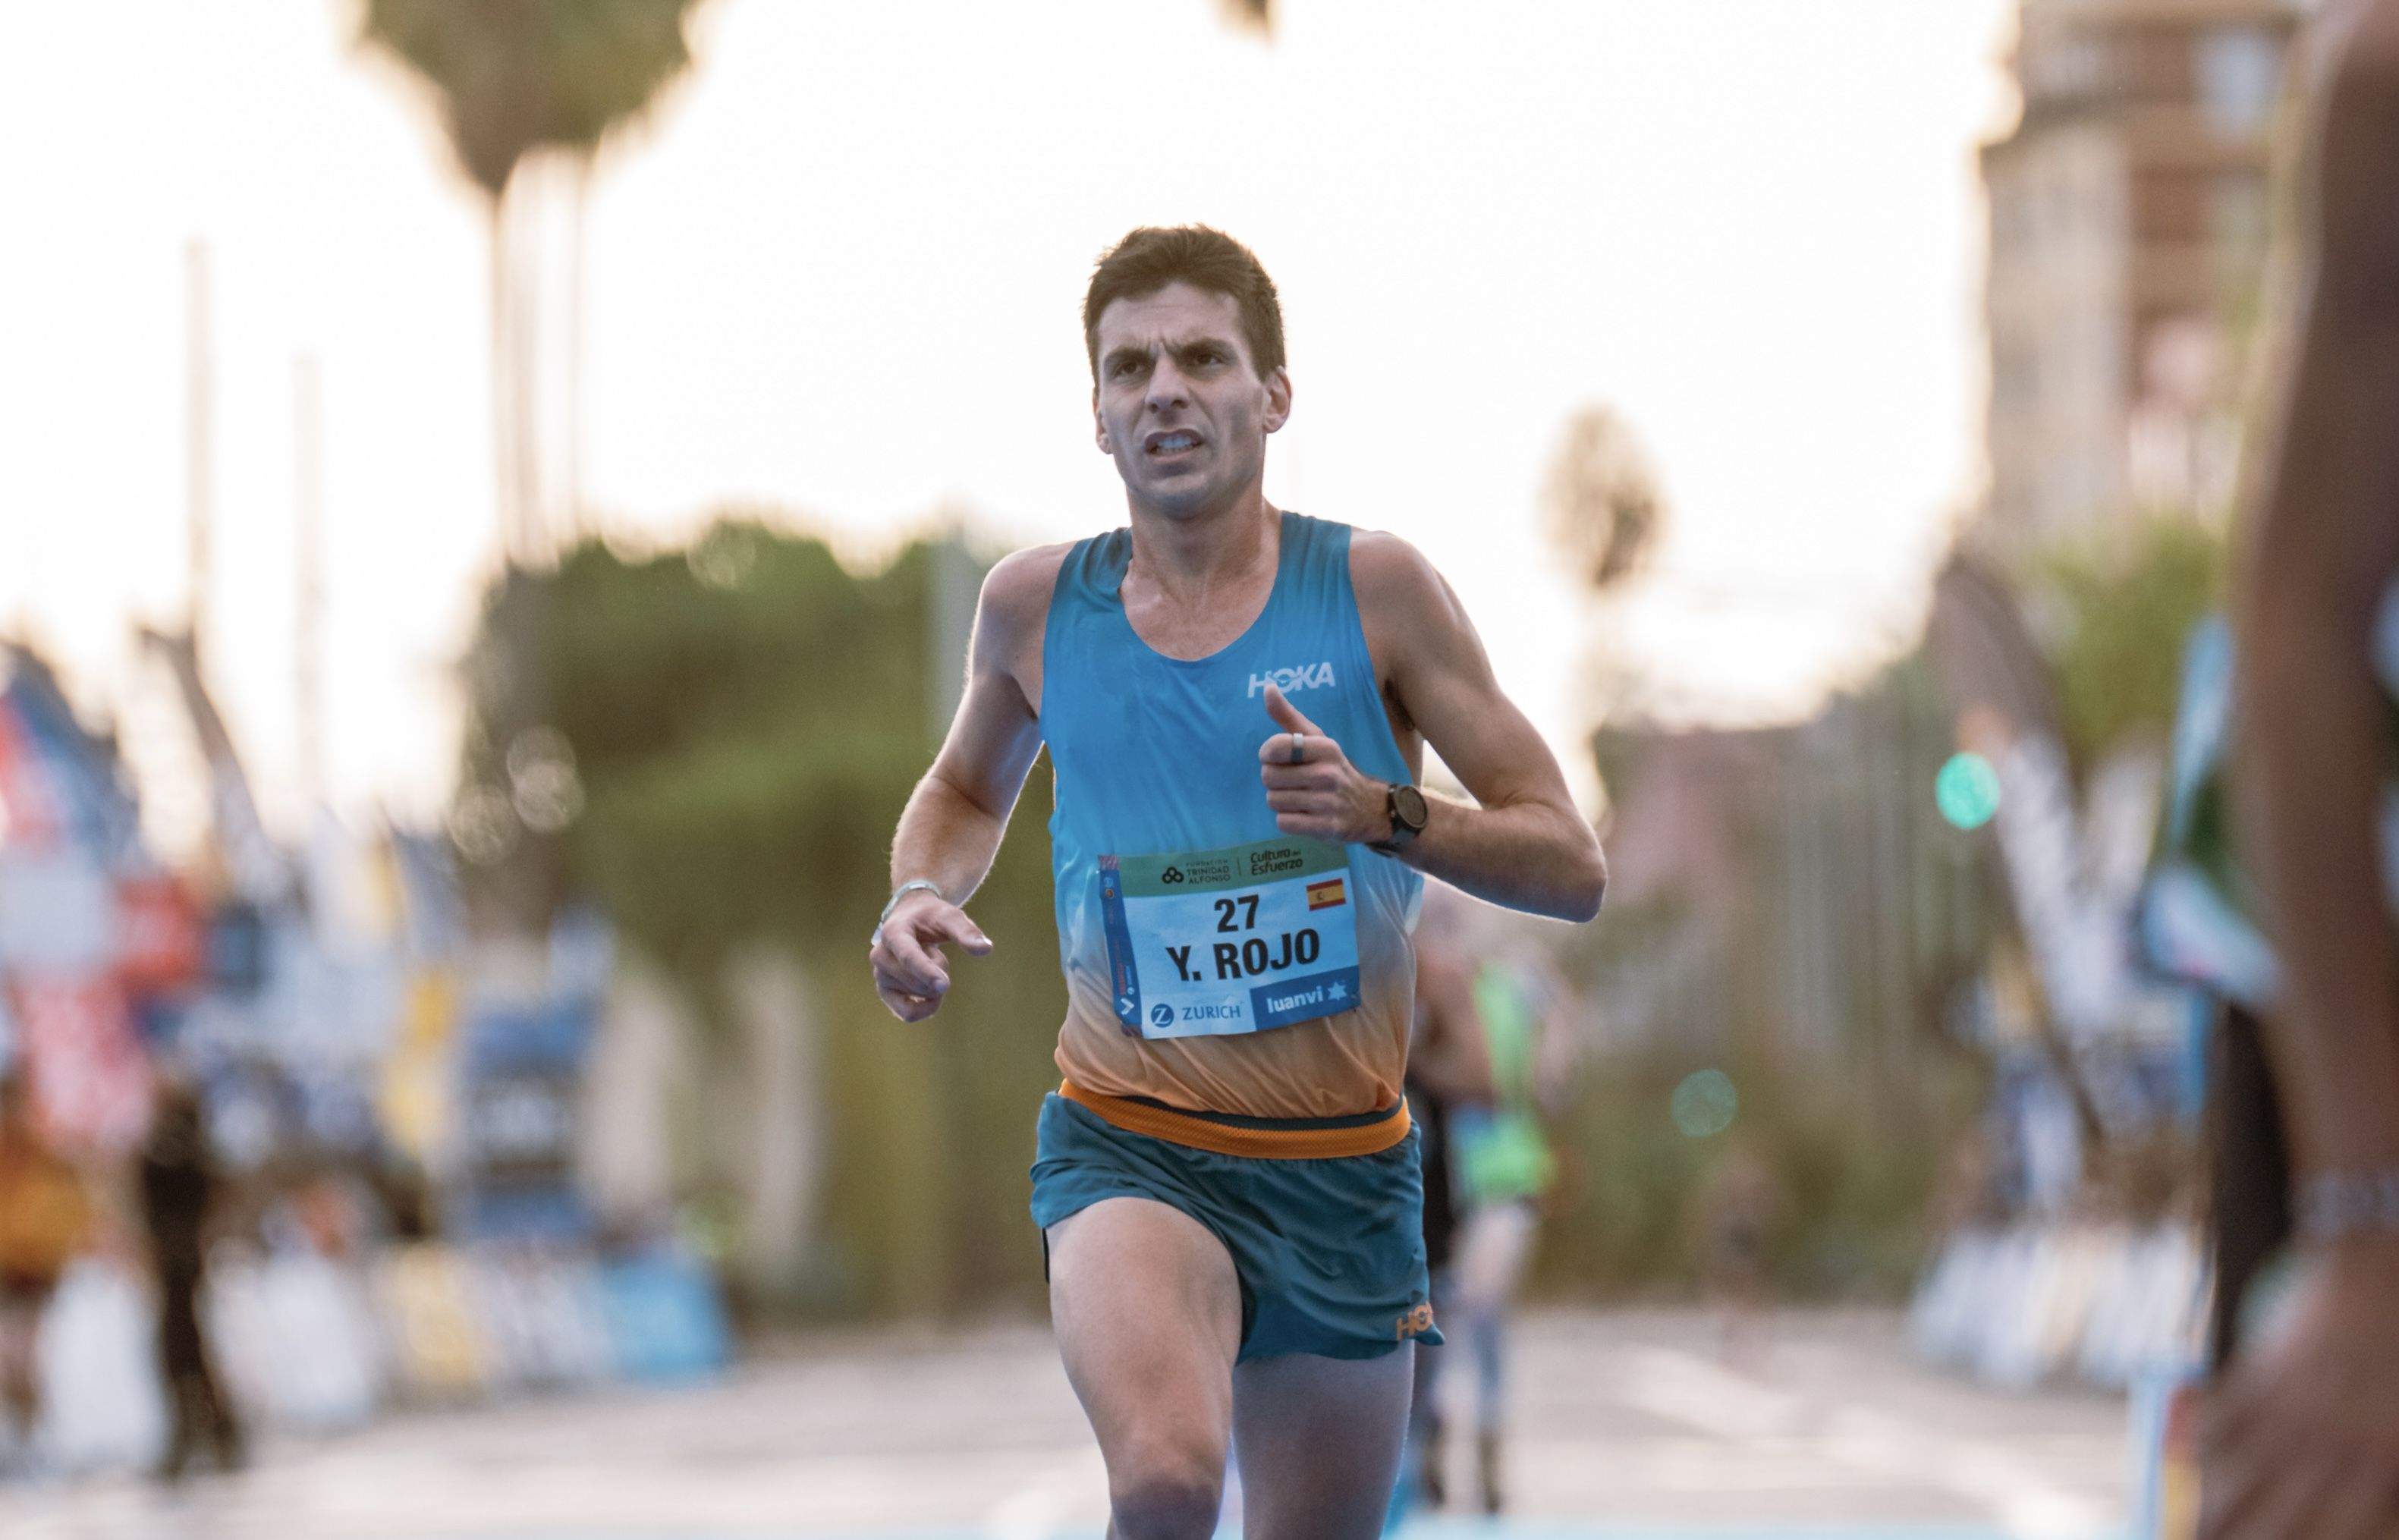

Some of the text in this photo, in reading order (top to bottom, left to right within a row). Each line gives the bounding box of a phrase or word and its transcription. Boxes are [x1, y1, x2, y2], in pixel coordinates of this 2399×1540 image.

[1247, 662, 1335, 698] HOKA
[1251, 849, 1291, 863] Cultura
[1187, 866, 1229, 876] TRINIDAD
[1252, 858, 1303, 875] Esfuerzo
[1188, 874, 1231, 885] ALFONSO
[1214, 894, 1259, 933] 27
[1165, 945, 1202, 982] Y.
[1213, 928, 1320, 980] ROJO
[1266, 986, 1323, 1014] luanvi
[1182, 1005, 1241, 1020] ZURICH
